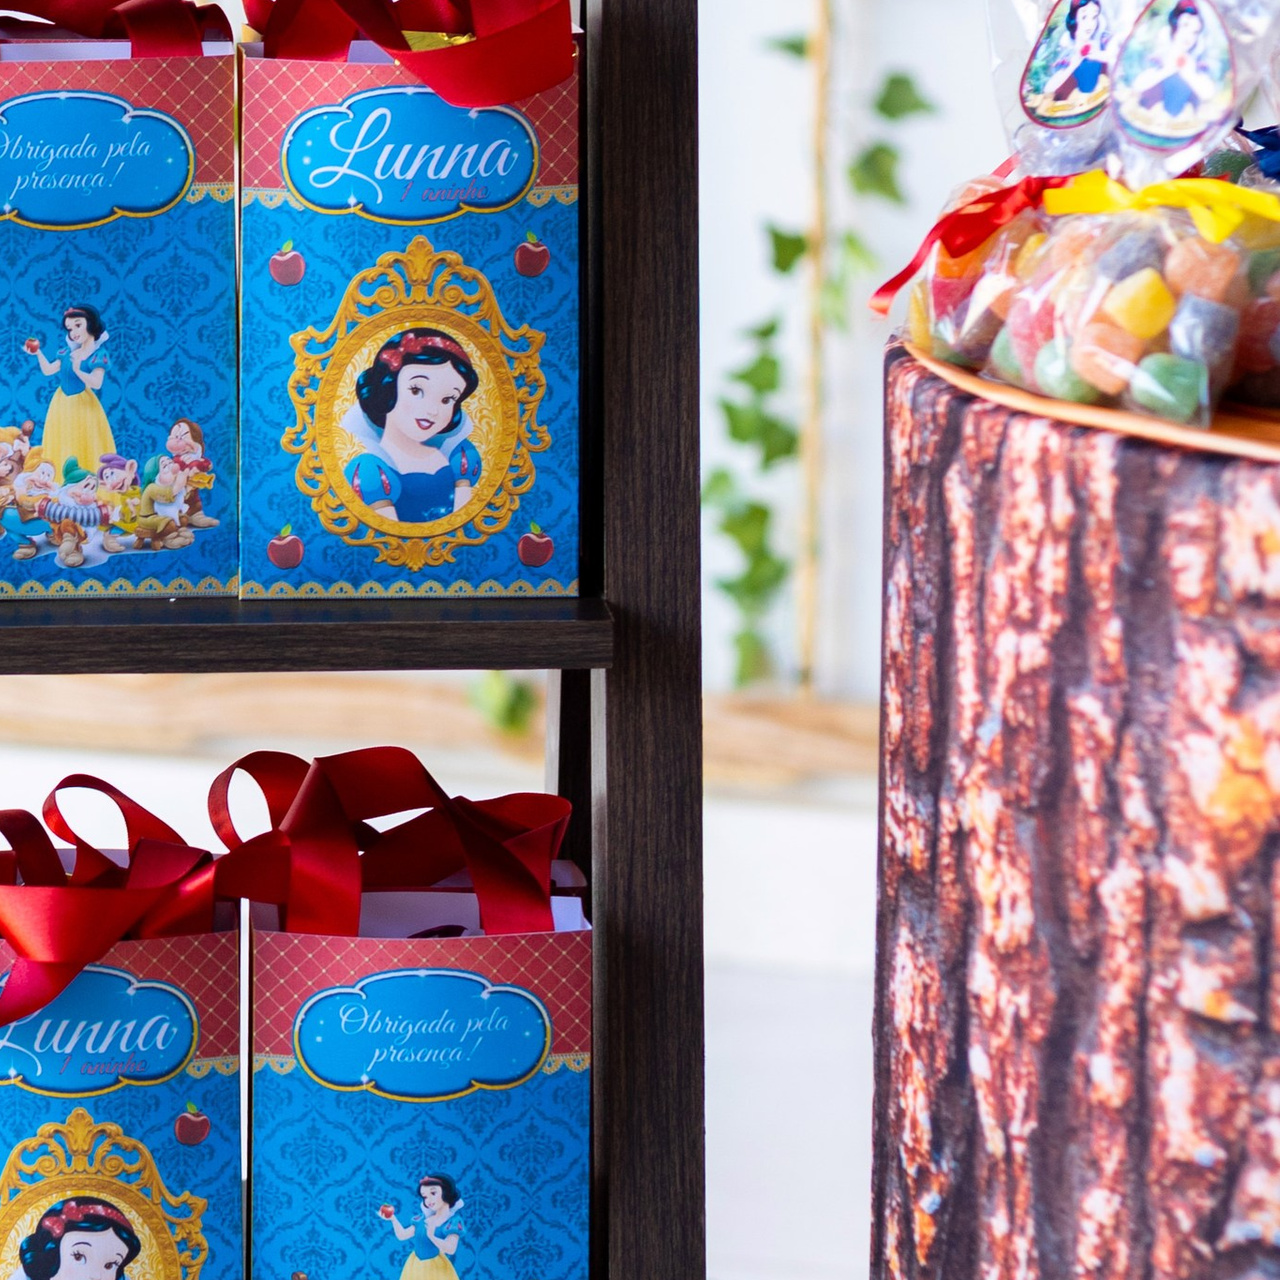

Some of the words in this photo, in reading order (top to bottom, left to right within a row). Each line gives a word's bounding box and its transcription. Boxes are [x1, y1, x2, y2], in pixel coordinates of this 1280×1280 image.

[101, 131, 153, 168] pela
[309, 107, 519, 204] Lunna
[9, 162, 125, 200] presença!
[339, 1002, 457, 1046] Obrigada
[460, 1007, 511, 1043] pela
[367, 1037, 483, 1071] presença!
